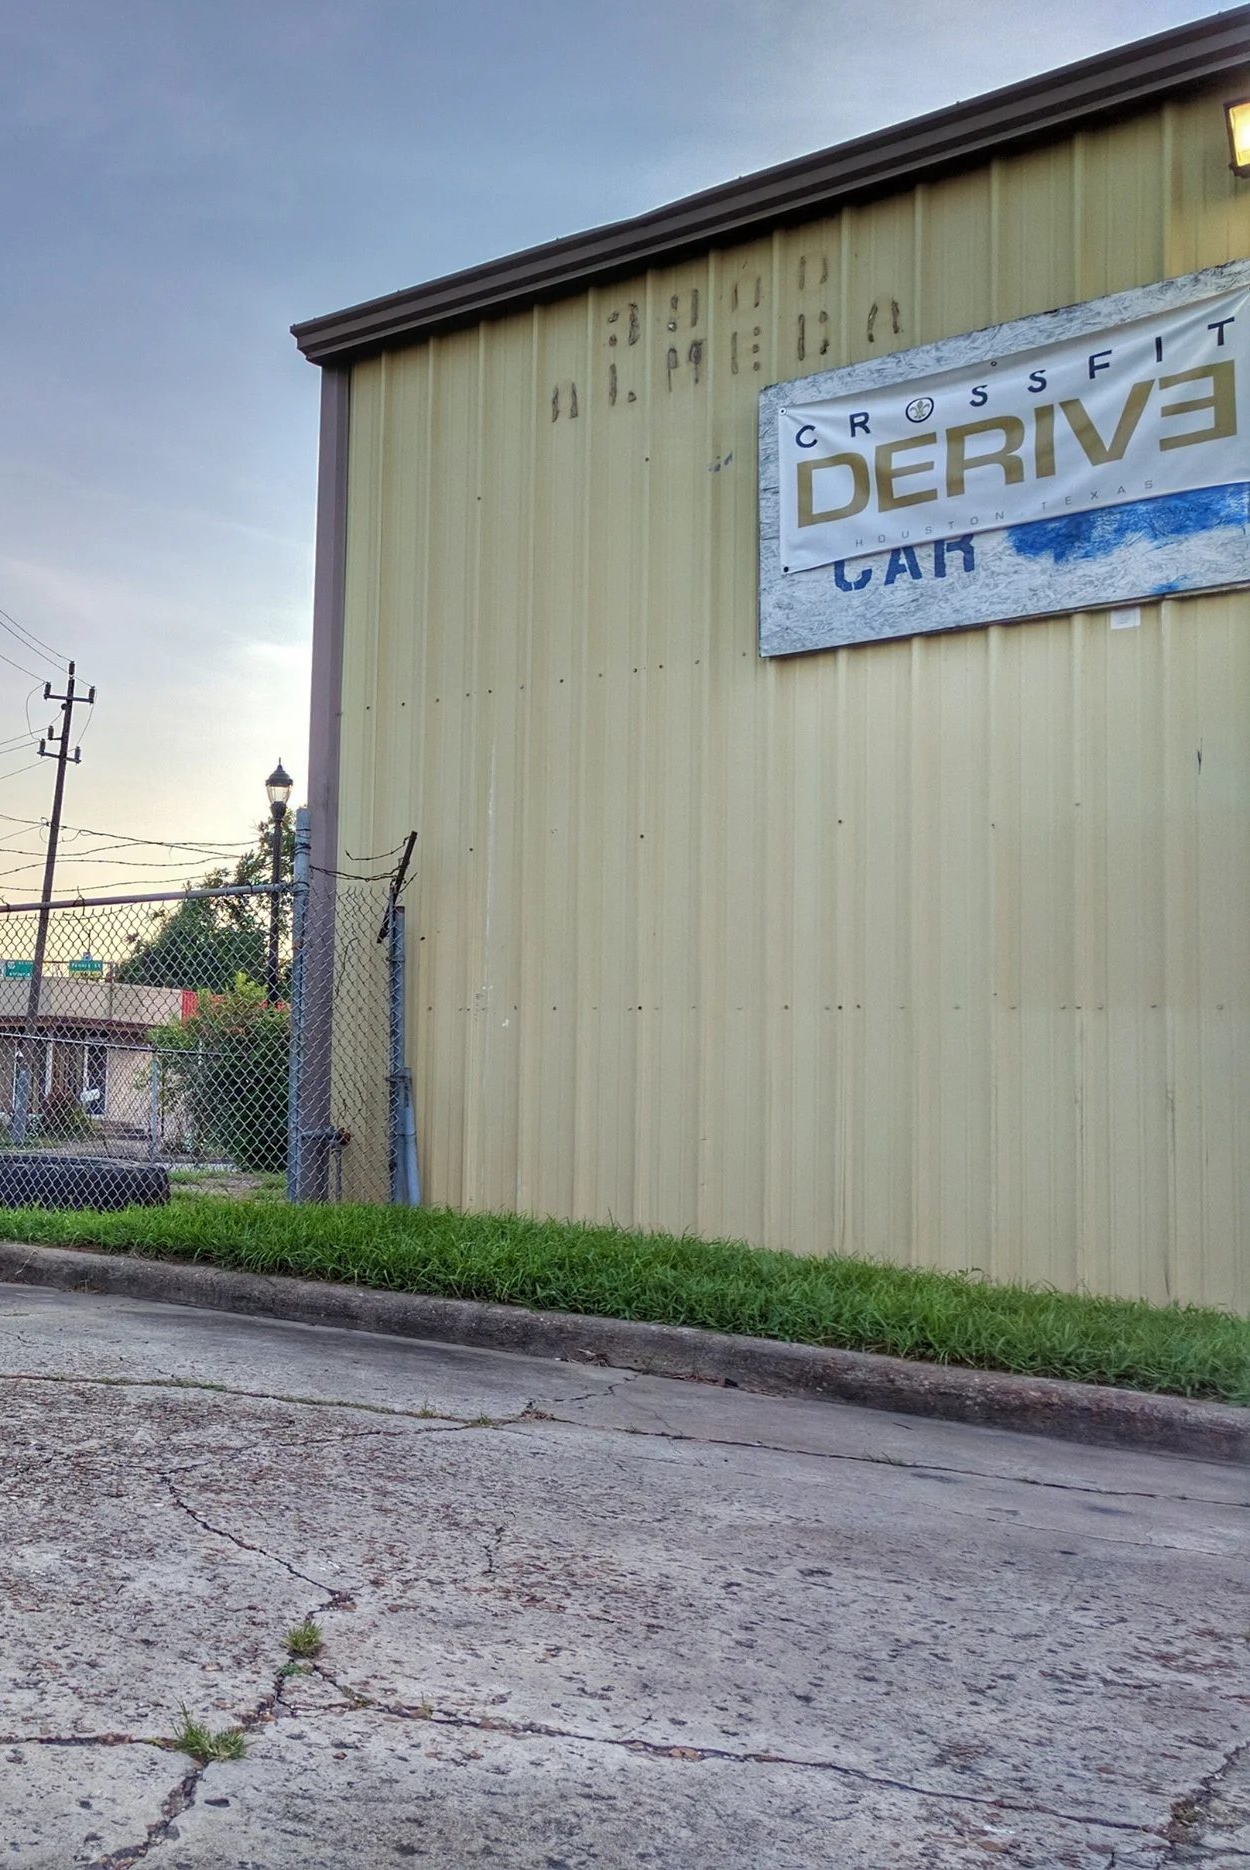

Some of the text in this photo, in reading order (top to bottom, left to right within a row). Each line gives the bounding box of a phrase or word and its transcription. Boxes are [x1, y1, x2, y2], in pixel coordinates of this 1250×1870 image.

[795, 317, 1236, 448] CROSSFIT
[796, 359, 1238, 529] DERIVE
[855, 480, 1154, 548] HOUSTON TEXAS
